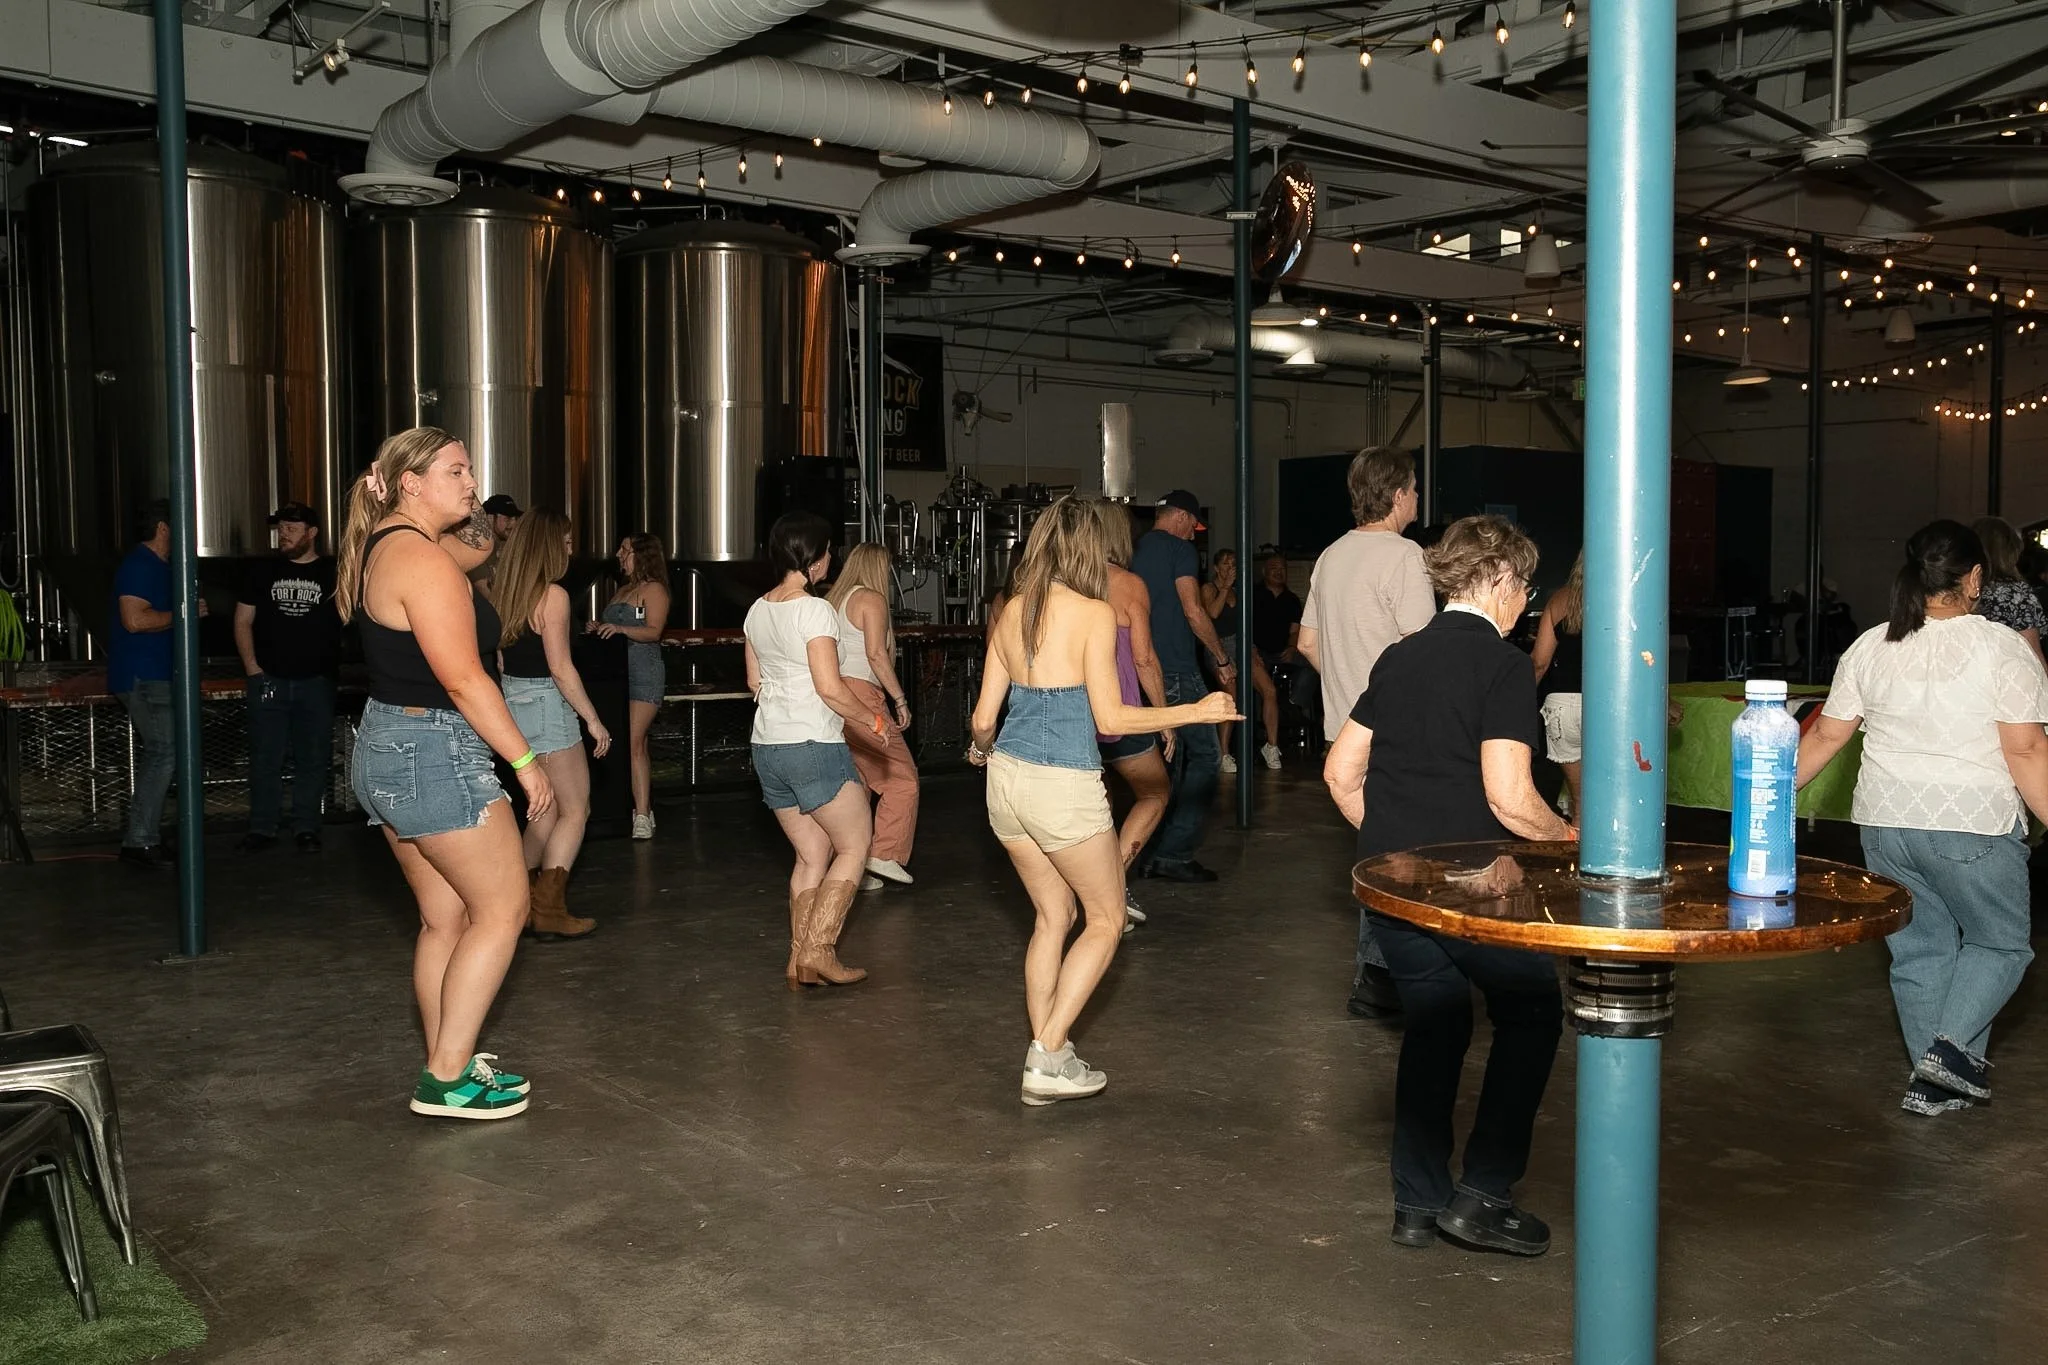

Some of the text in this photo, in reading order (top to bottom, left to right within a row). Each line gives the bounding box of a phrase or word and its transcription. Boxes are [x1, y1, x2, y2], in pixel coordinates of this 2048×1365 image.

[879, 372, 920, 405] OCK
[896, 448, 920, 462] BEER
[271, 588, 323, 604] FORT ROCK
